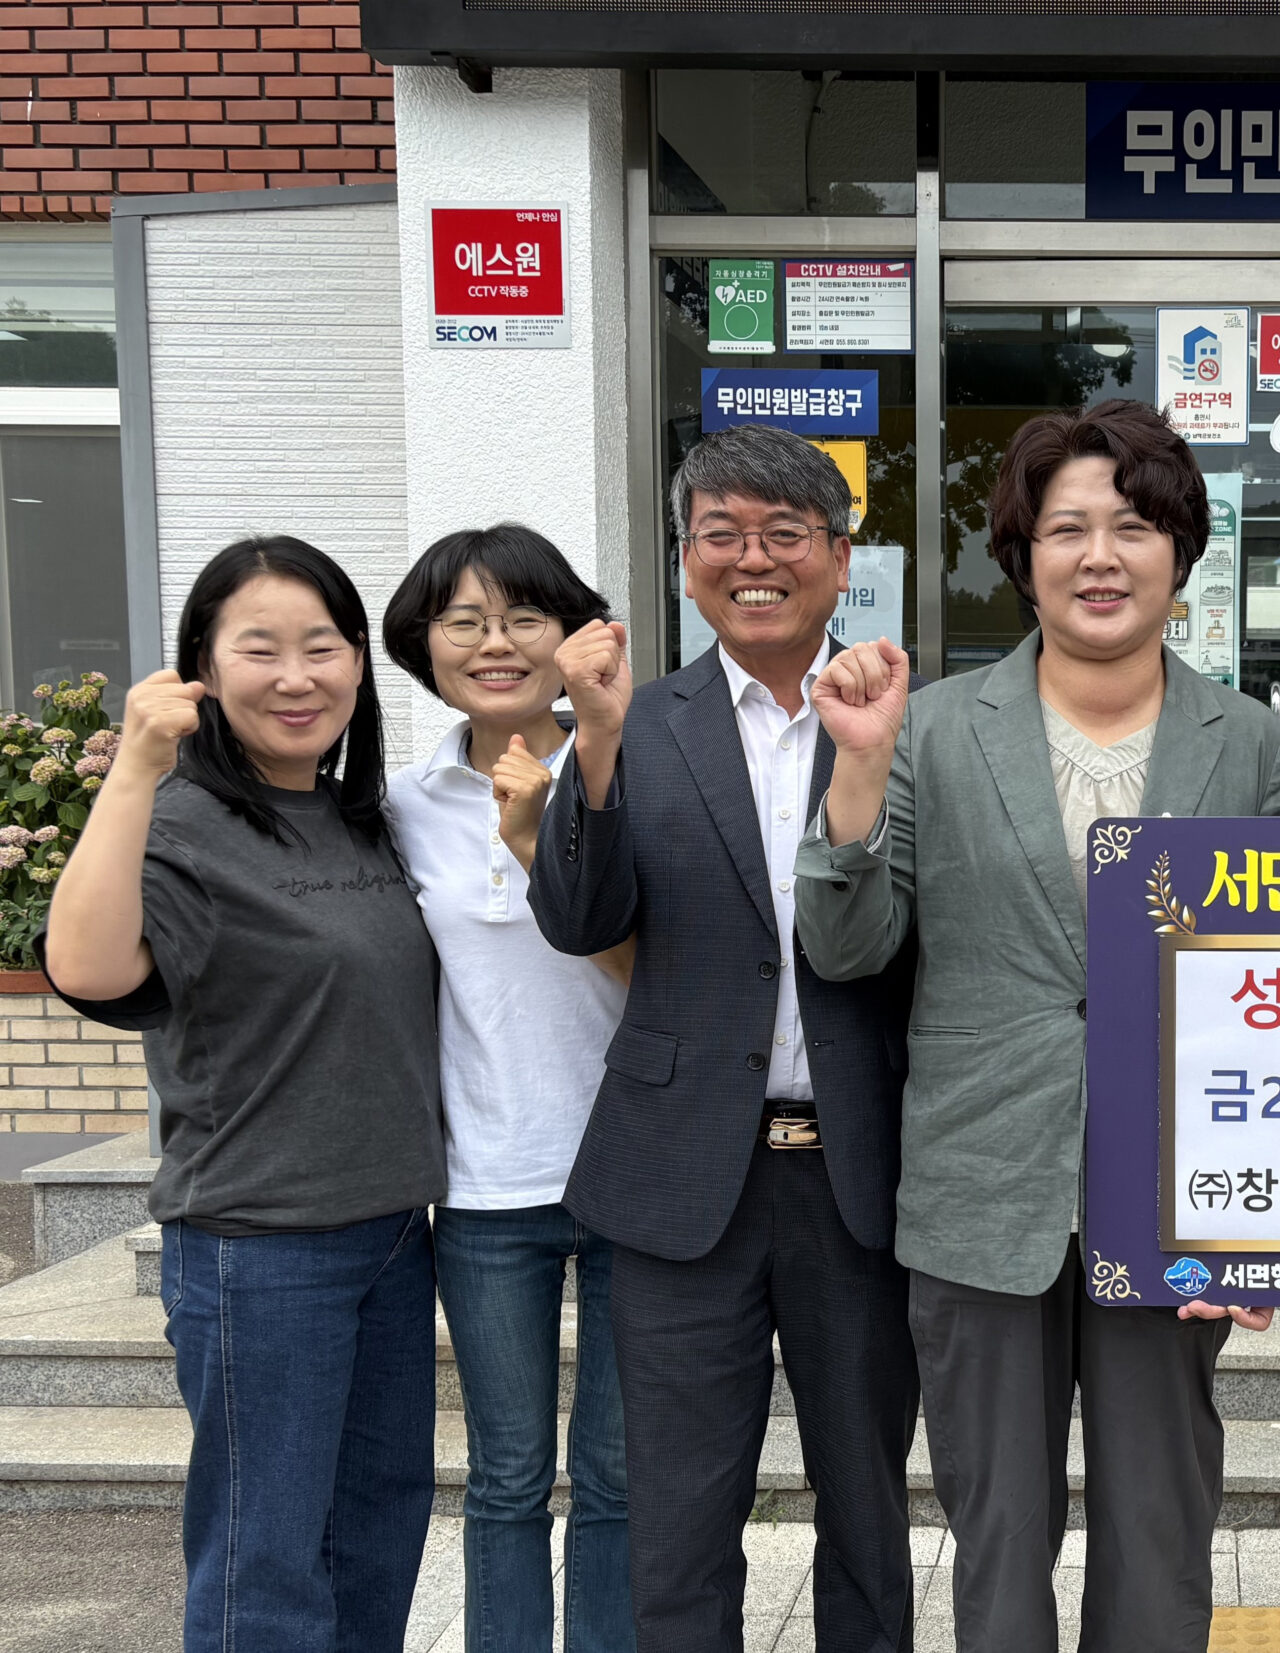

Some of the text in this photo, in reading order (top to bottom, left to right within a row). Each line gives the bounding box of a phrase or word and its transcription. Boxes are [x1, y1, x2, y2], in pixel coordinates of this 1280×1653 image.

[516, 212, 558, 222] 언제나 안심
[454, 242, 541, 277] 에스원
[715, 269, 768, 278] 자동심장충격기
[800, 264, 881, 276] CCTV 설치안내
[468, 285, 529, 297] CCTV 작동중
[735, 289, 767, 303] AED
[436, 325, 497, 342] SECOM
[716, 387, 863, 417] 무인민원발급창구
[1174, 392, 1232, 409] 금연구역
